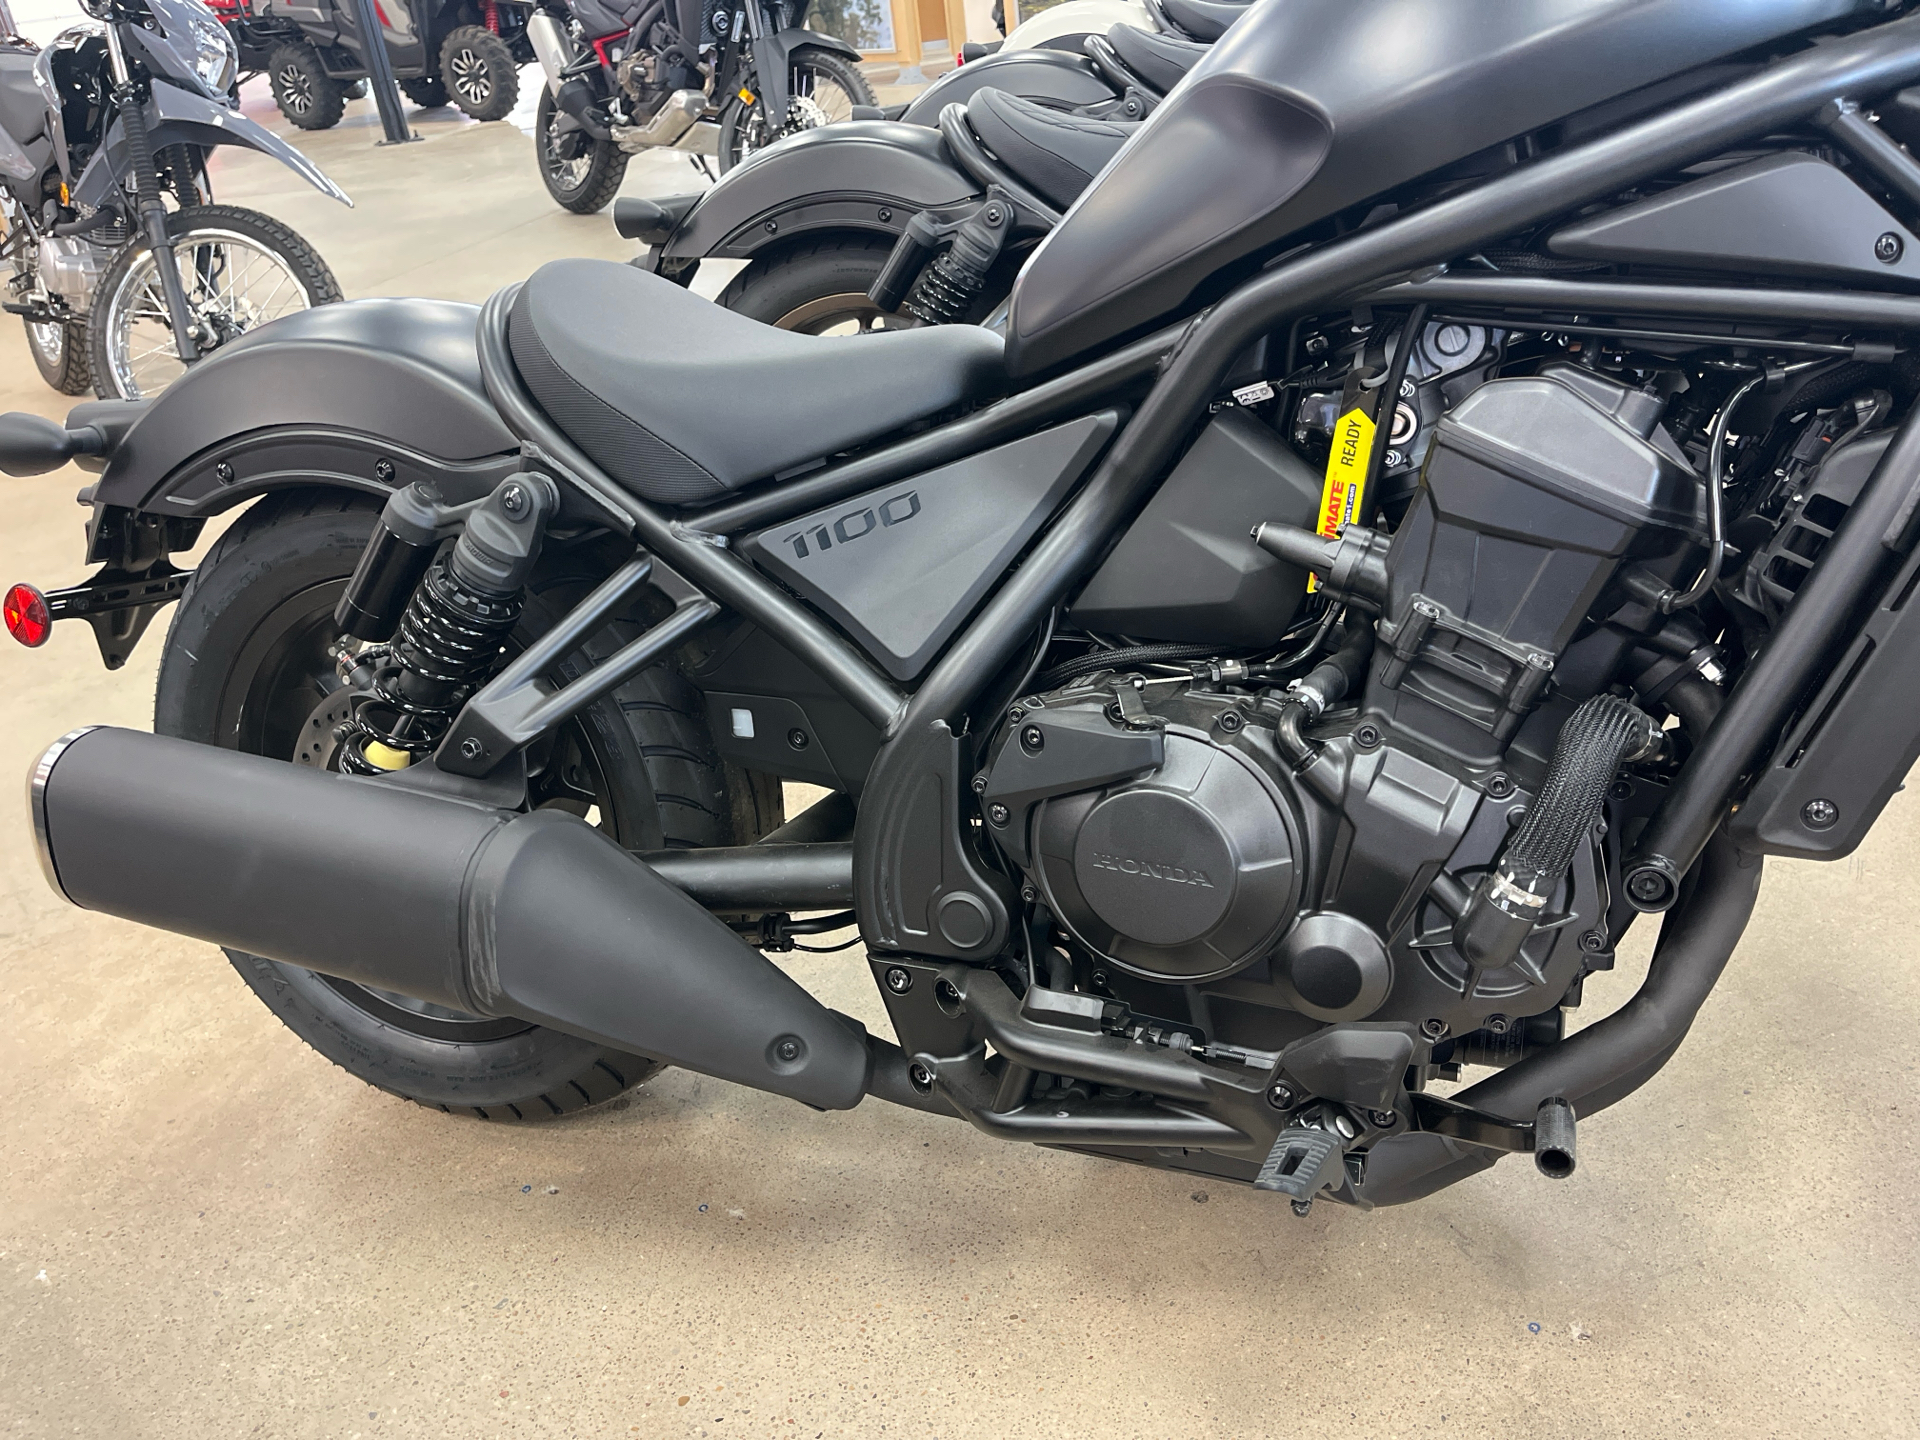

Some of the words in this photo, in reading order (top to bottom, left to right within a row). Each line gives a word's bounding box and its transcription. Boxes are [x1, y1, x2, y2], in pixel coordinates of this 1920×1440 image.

[1341, 418, 1362, 467] READY
[782, 489, 922, 559] 1100
[1319, 480, 1344, 539] iMATE
[1092, 852, 1215, 889] HONDA
